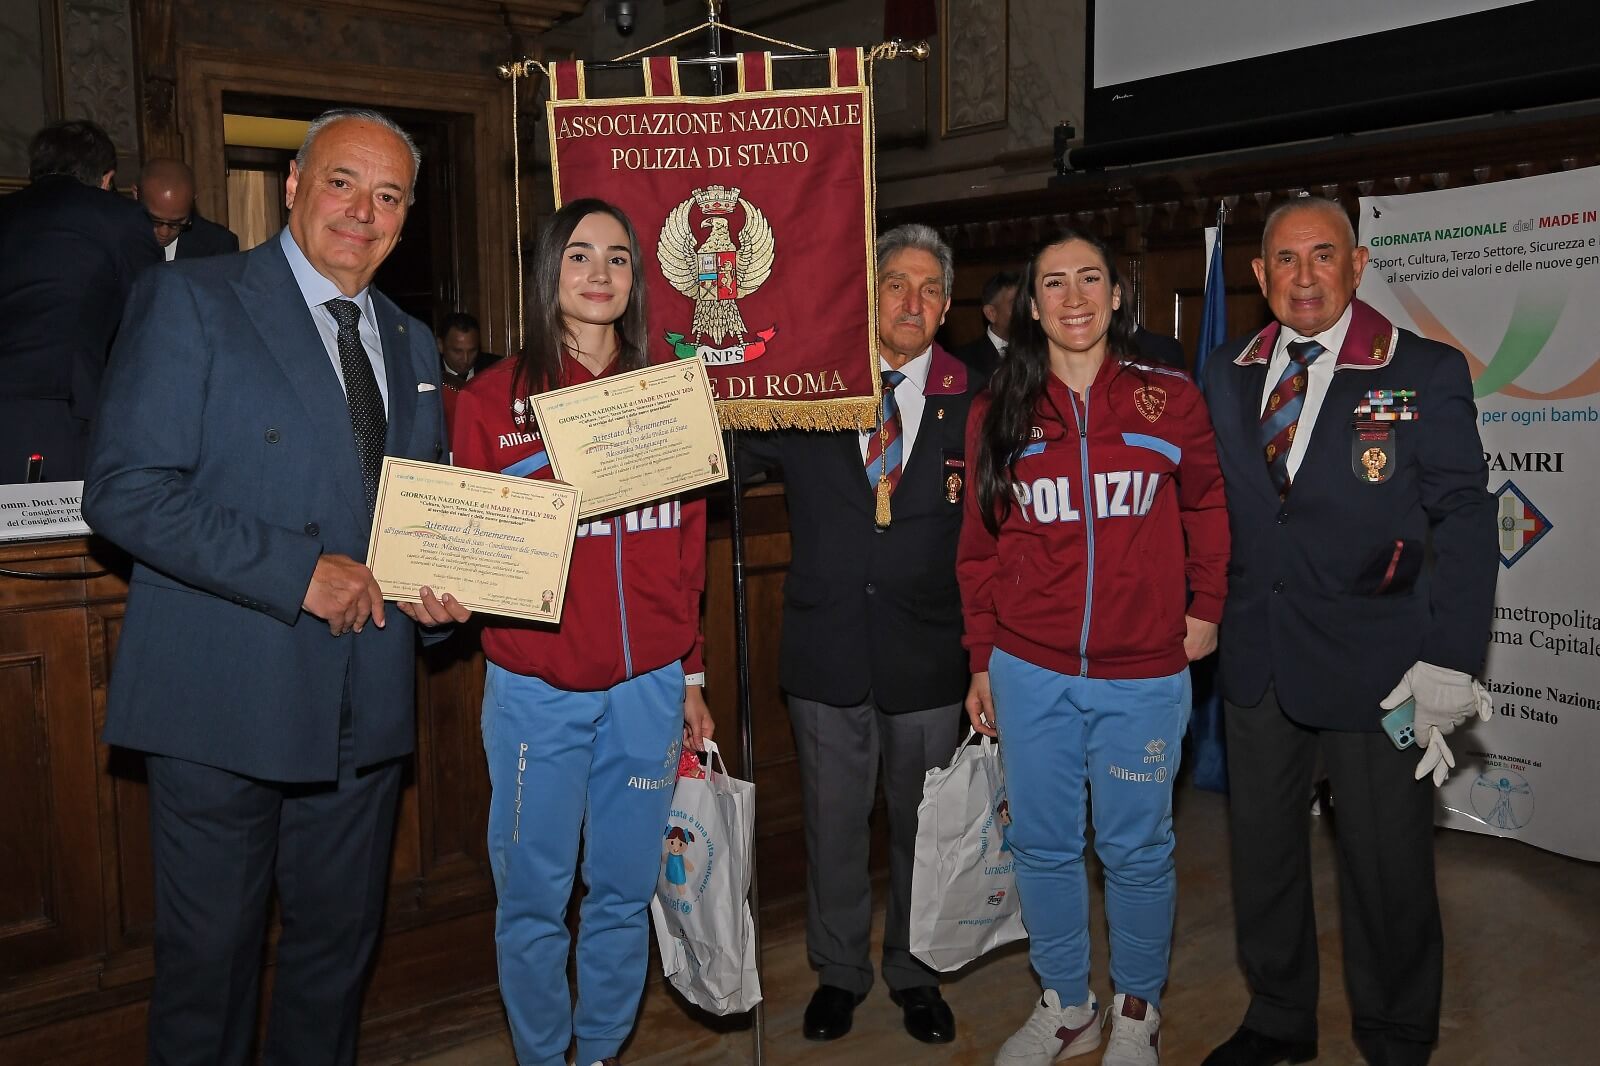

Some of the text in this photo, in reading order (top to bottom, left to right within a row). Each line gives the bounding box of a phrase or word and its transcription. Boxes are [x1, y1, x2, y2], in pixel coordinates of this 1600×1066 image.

[557, 103, 861, 140] ASSOCIAZIONE NAZIONALE
[611, 140, 809, 170] POLIZIA DI STATO
[1370, 210, 1597, 247] GIORNATA NAZIONALE del MADE IN
[1408, 252, 1449, 267] Cultura,
[1451, 249, 1480, 261] Terzo
[1484, 244, 1527, 260] Settore,
[1529, 238, 1585, 253] Sicurezza
[1588, 237, 1596, 247] e
[1387, 272, 1397, 284] al
[1399, 269, 1439, 282] servizio
[1442, 265, 1459, 279] dei
[1461, 263, 1492, 277] valori
[1495, 264, 1502, 274] e
[1504, 257, 1532, 273] delle
[1535, 257, 1573, 270] nuove
[701, 349, 744, 363] ANPS
[726, 375, 757, 399] DI
[763, 369, 848, 397] ROMA
[557, 410, 591, 425] GIORNATA
[590, 401, 628, 416] NAZIONALE
[636, 395, 655, 404] MADE
[663, 388, 682, 398] ITALY
[1482, 406, 1599, 426] per ogni bamb
[498, 432, 541, 449] Allian
[0, 502, 30, 510] omm.
[32, 499, 57, 507] Dott.
[400, 489, 437, 502] GIORNATA
[437, 495, 479, 508] NAZIONALE
[490, 504, 511, 513] MADE
[520, 509, 543, 518] ITALY
[21, 518, 57, 526] Consiglio
[59, 515, 70, 523] dei
[472, 526, 525, 545] Benemerenza
[1500, 703, 1515, 717] di
[1520, 705, 1558, 725] Stato
[1110, 766, 1153, 782] Allianz
[670, 809, 687, 820] ttata
[984, 861, 1011, 875] unicef
